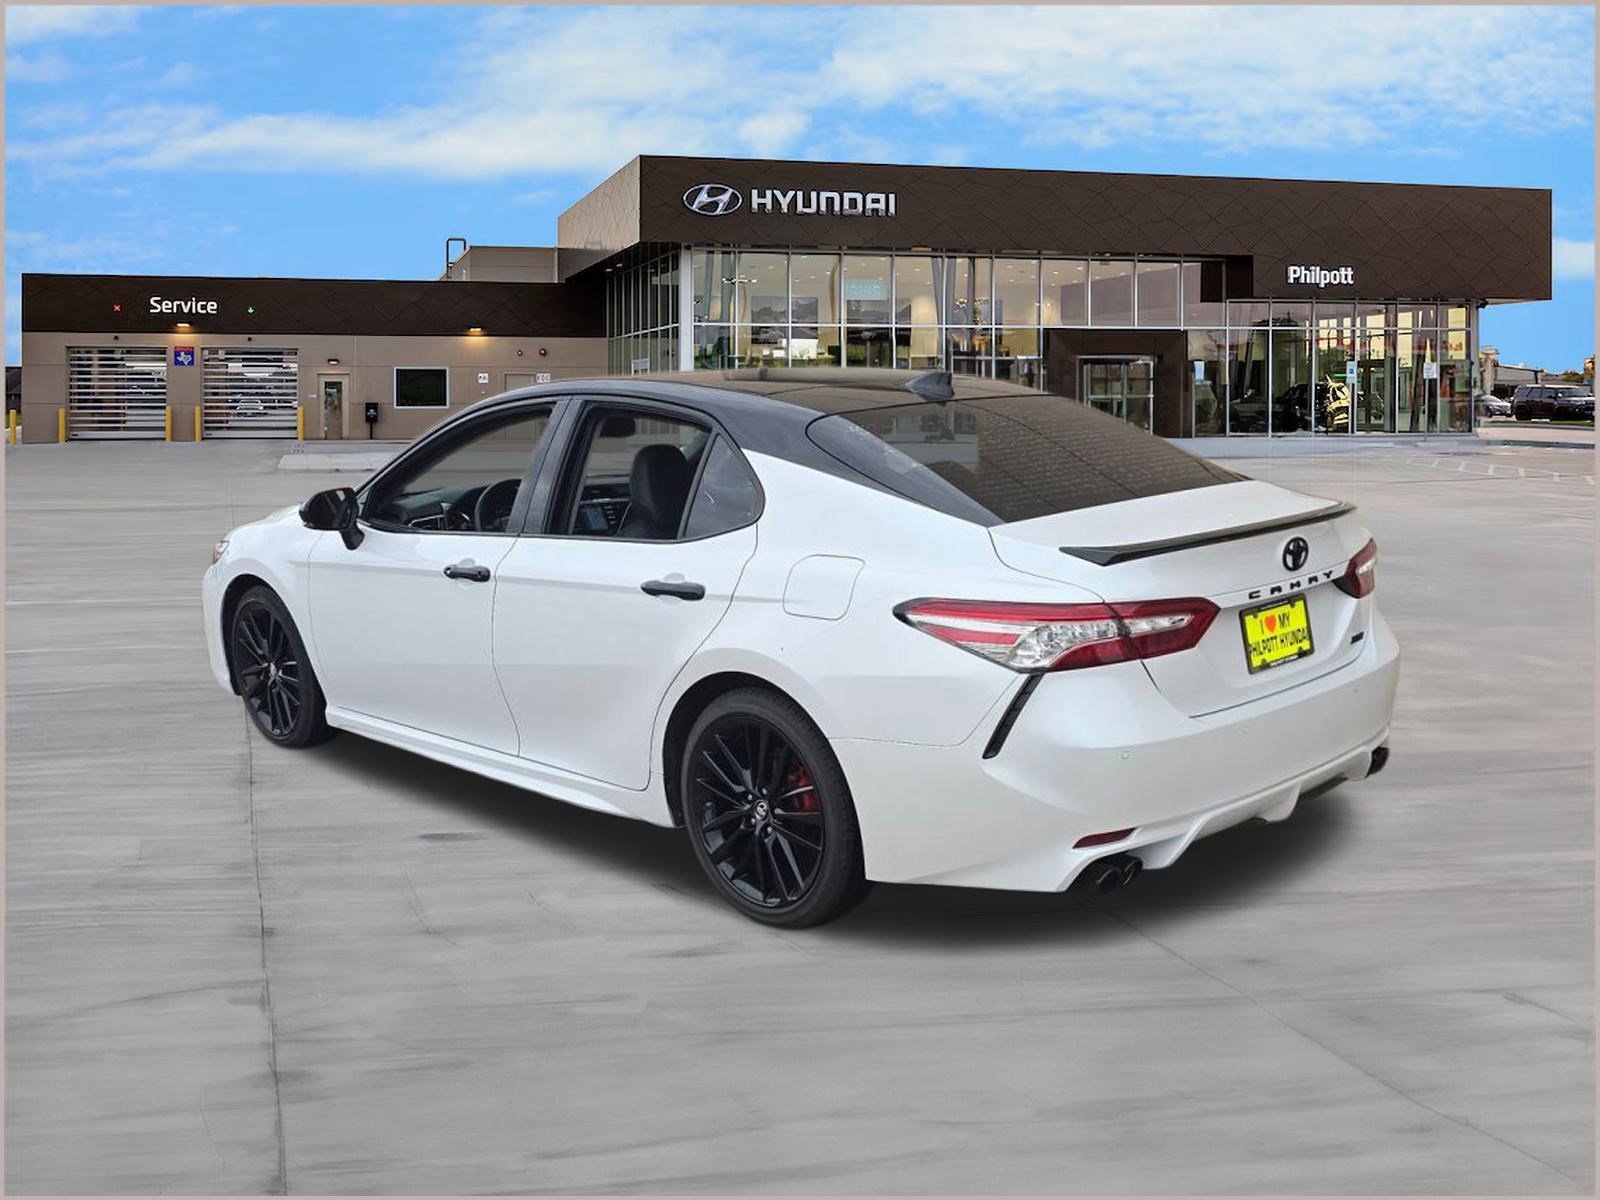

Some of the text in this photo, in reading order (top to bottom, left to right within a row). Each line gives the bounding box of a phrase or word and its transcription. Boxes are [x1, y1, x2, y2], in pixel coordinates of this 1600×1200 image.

[751, 189, 896, 216] HYUNDAI
[1287, 266, 1354, 288] Philpott
[149, 297, 218, 314] Service
[1248, 570, 1334, 600] CAMRY
[1278, 612, 1291, 630] MY
